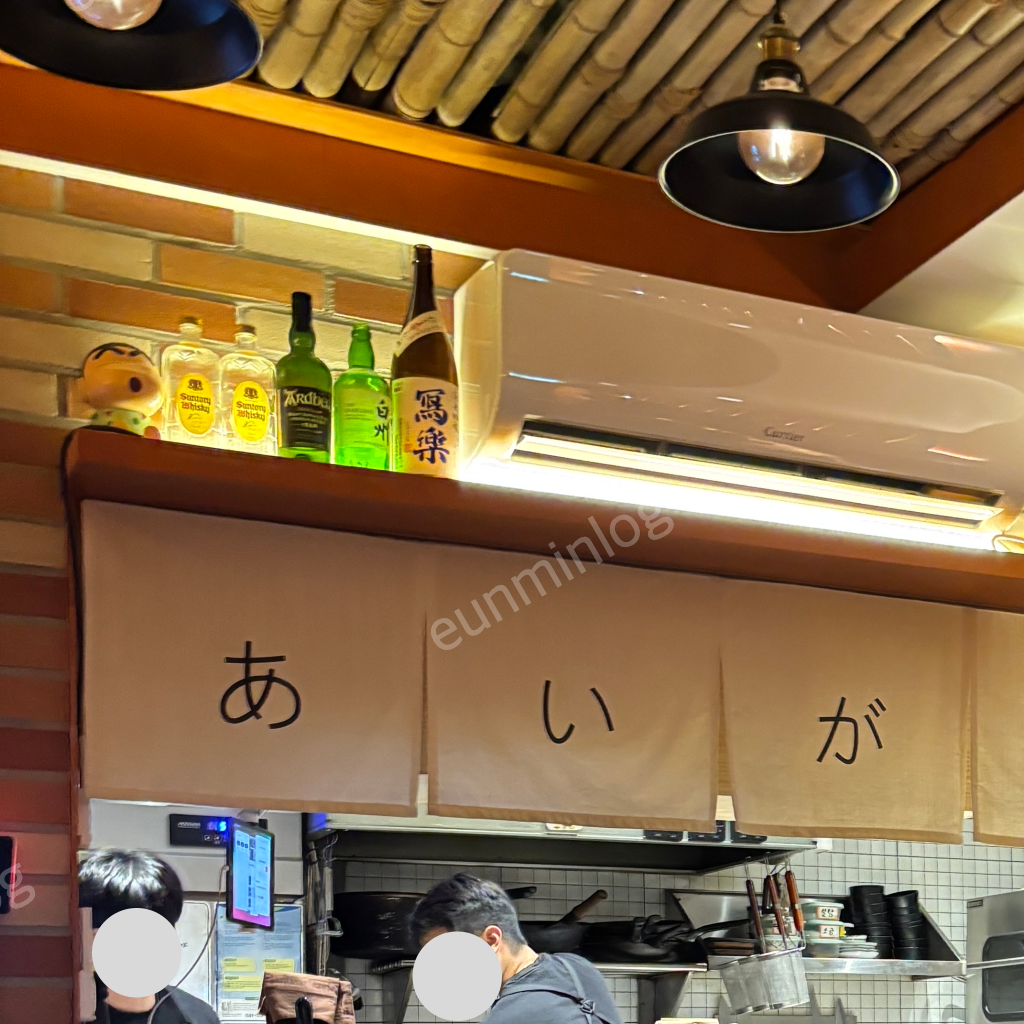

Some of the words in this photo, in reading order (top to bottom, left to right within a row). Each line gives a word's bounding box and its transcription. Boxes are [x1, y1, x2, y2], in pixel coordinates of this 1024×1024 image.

[180, 393, 211, 405] Suntory
[181, 402, 210, 413] Whisky
[236, 401, 266, 412] Suntory
[237, 410, 265, 421] Whisky
